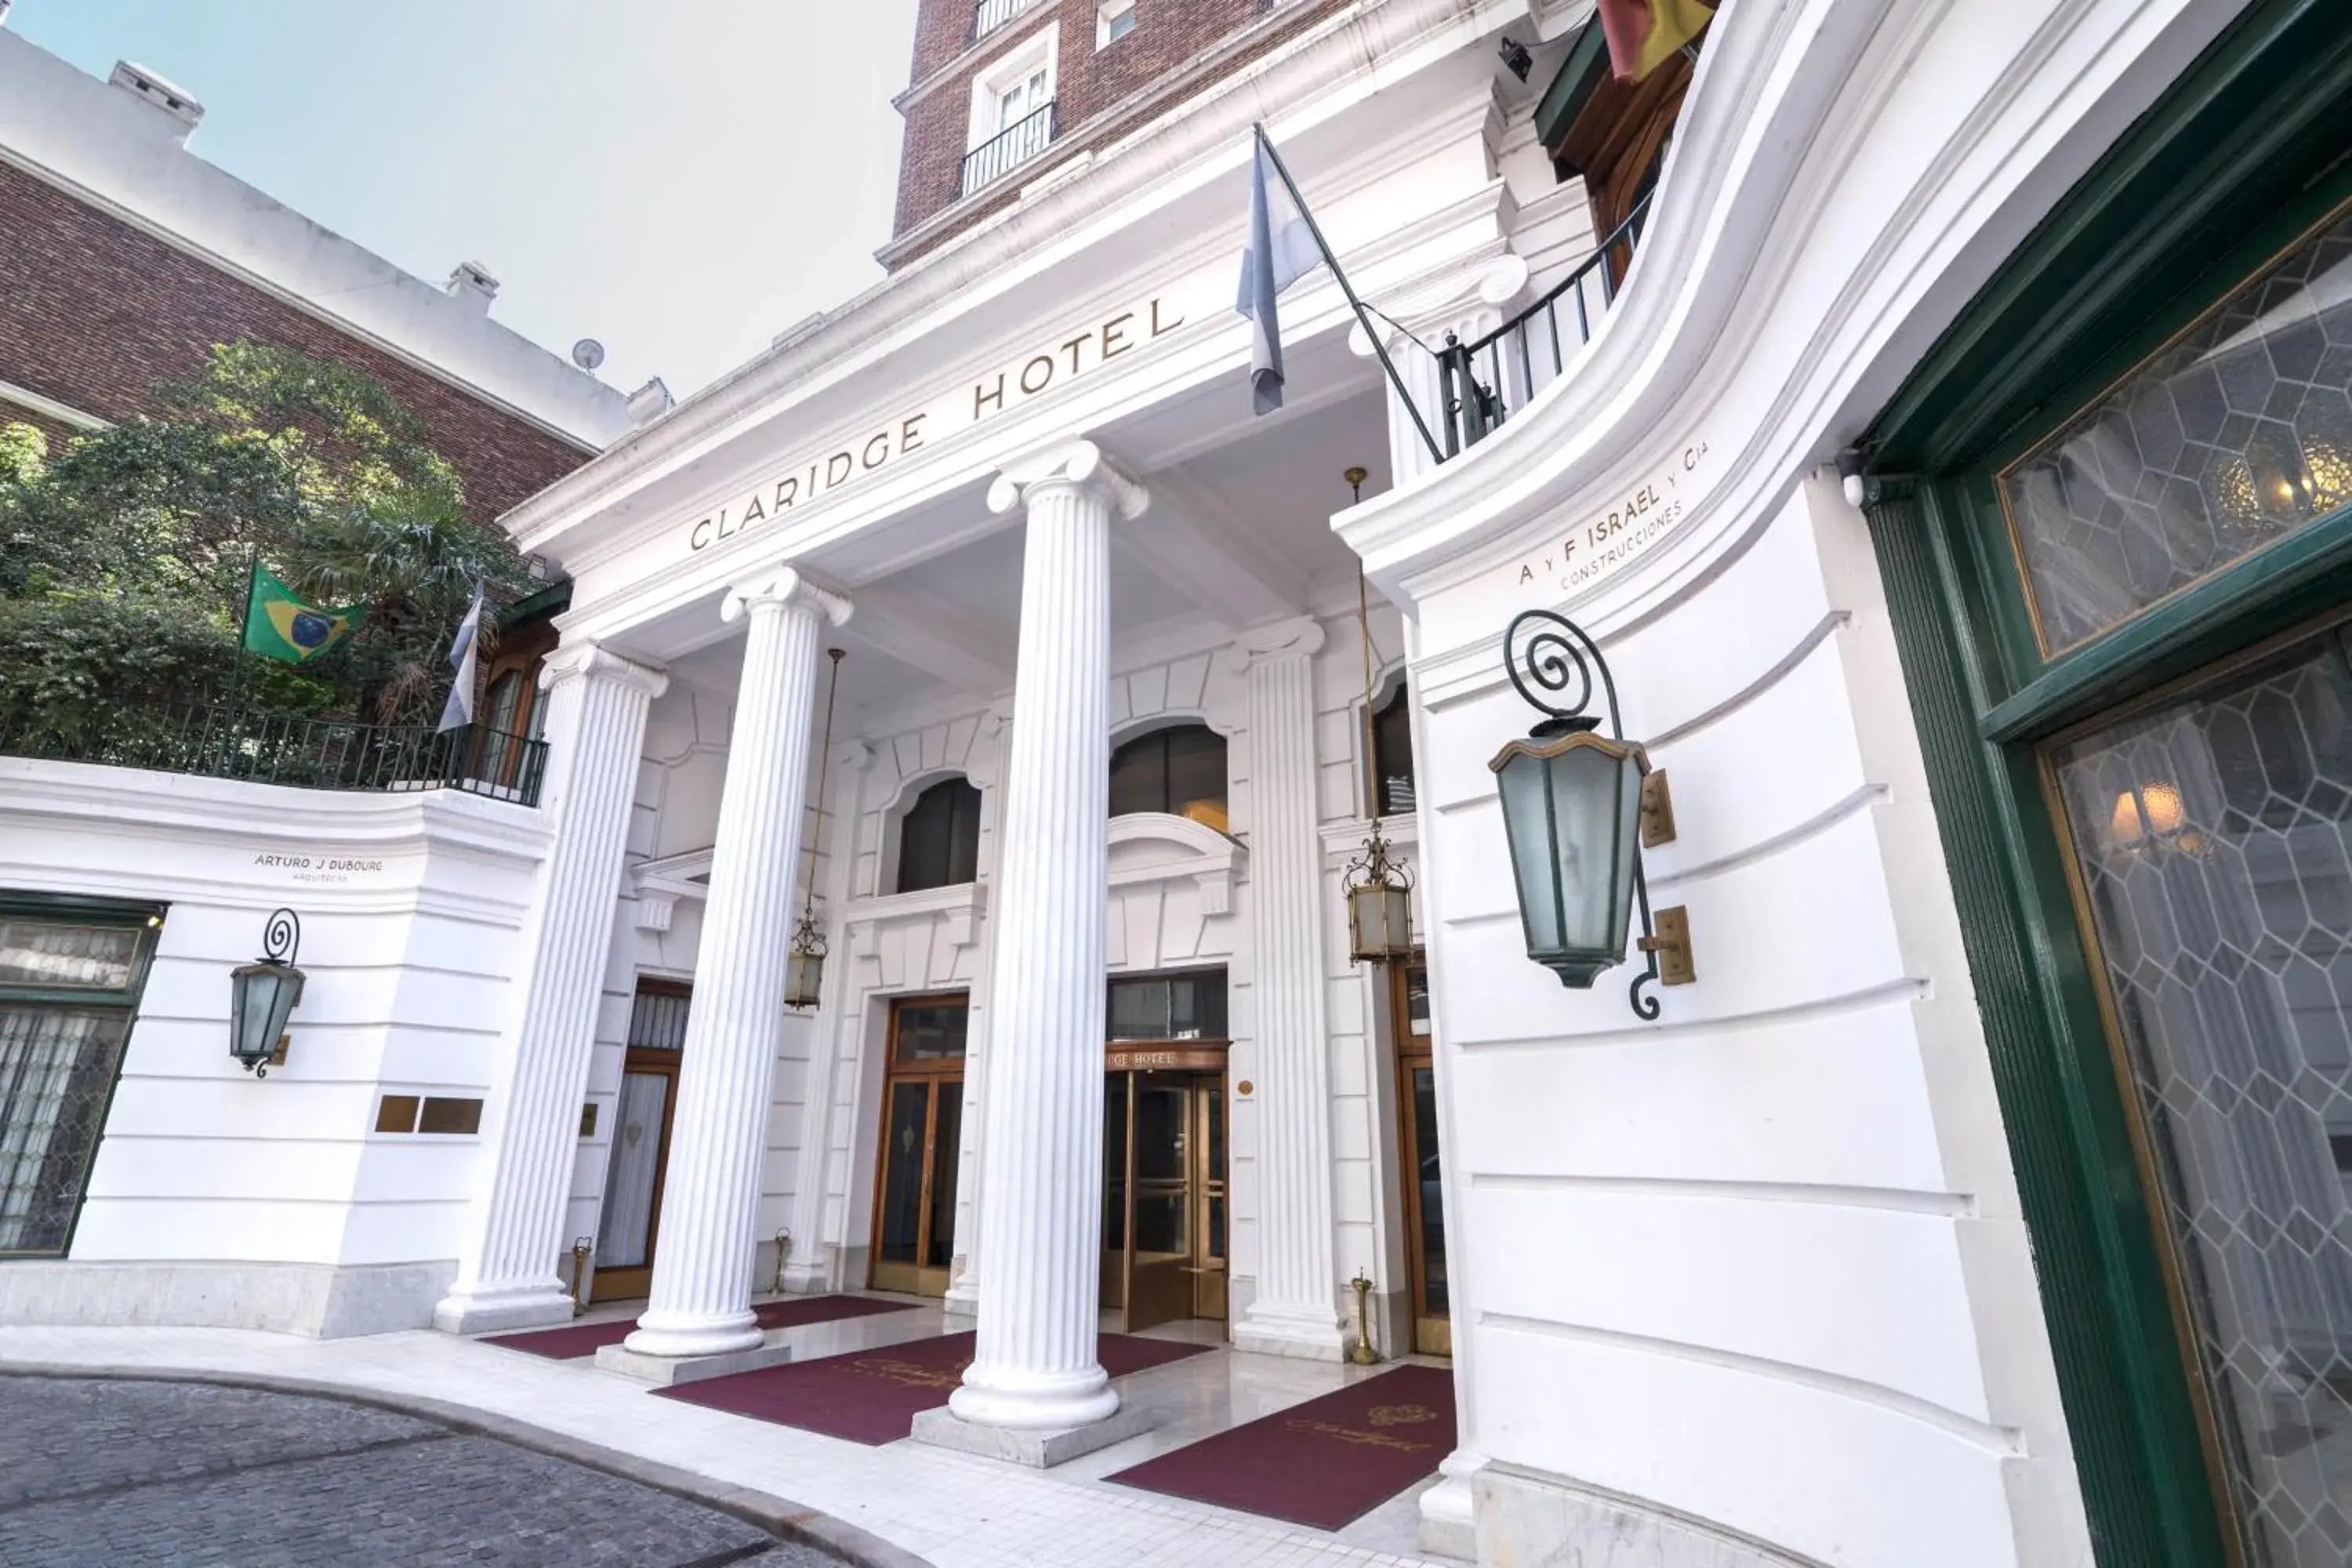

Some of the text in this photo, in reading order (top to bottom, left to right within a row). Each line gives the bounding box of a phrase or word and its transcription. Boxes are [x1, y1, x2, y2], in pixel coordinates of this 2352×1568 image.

[691, 298, 1184, 551] CLARIDGE HOTEL
[1519, 565, 1534, 586] A
[1565, 539, 1576, 561] F
[1588, 485, 1660, 548] ISRAEL
[1562, 499, 1682, 590] CONSTRUCCIONES
[255, 855, 383, 871] ARTURO J DUBOURG
[1134, 1052, 1176, 1065] HOTEL
